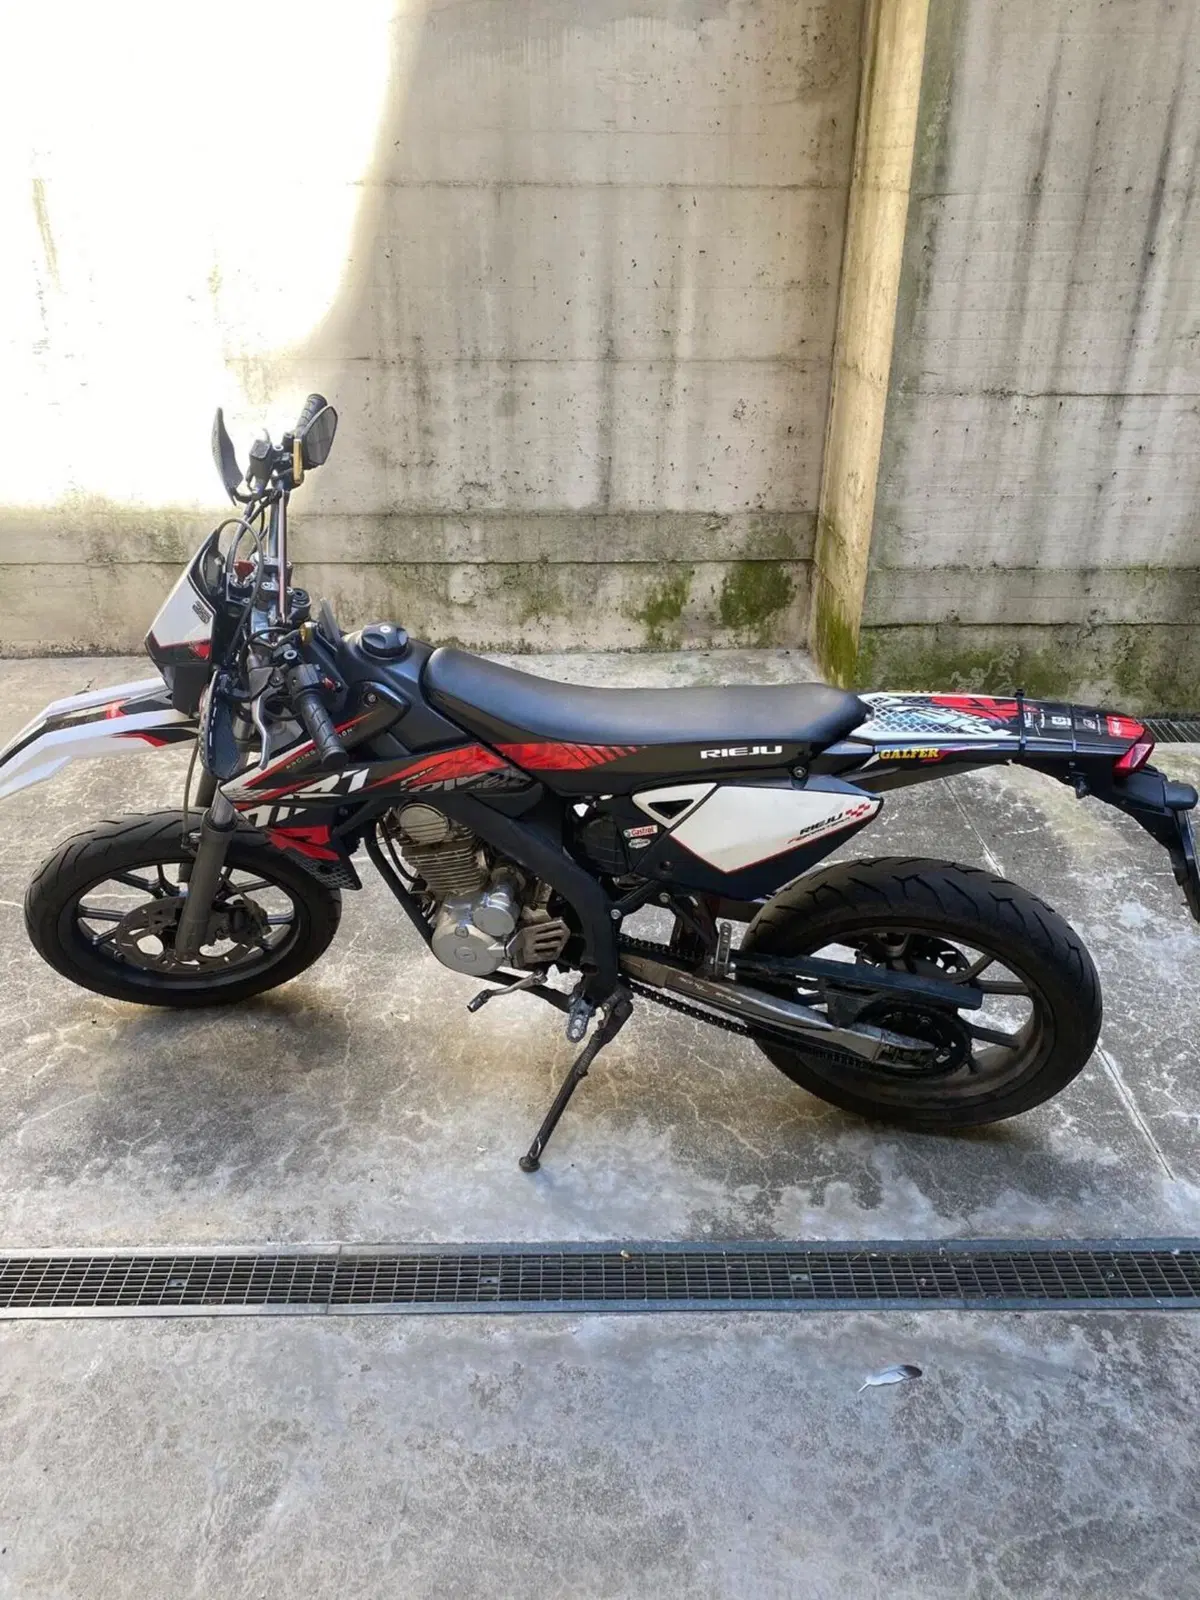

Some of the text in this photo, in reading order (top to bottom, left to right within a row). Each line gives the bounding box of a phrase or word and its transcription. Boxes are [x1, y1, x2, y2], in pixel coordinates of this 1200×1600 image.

[700, 745, 783, 759] RIEJU
[880, 747, 940, 760] GALFER
[799, 812, 843, 835] RIEJU
[631, 826, 655, 836] Castrol
